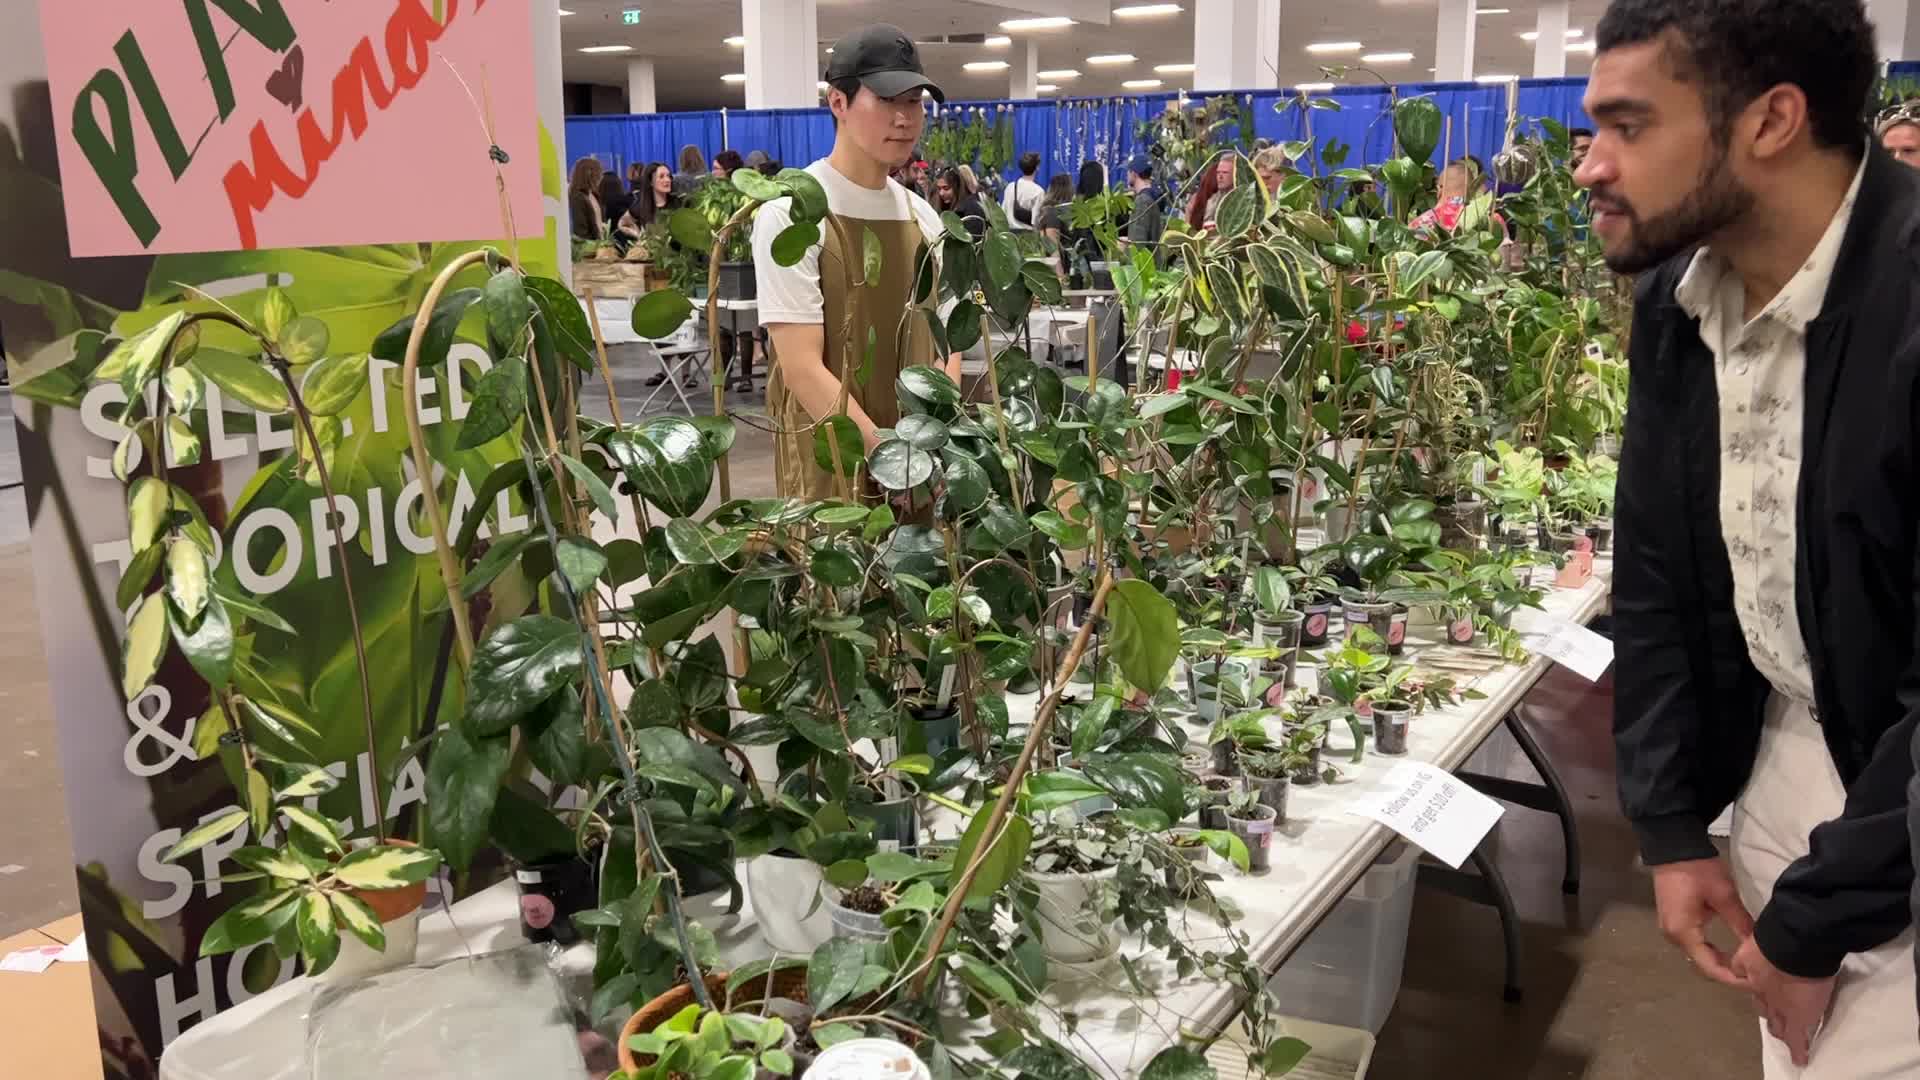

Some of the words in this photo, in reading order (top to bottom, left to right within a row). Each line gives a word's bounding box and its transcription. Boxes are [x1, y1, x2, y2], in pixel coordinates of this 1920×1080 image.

[93, 463, 529, 626] TOPICAL
[124, 685, 198, 777] &
[1411, 814, 1429, 833] and
[1422, 805, 1439, 824] get
